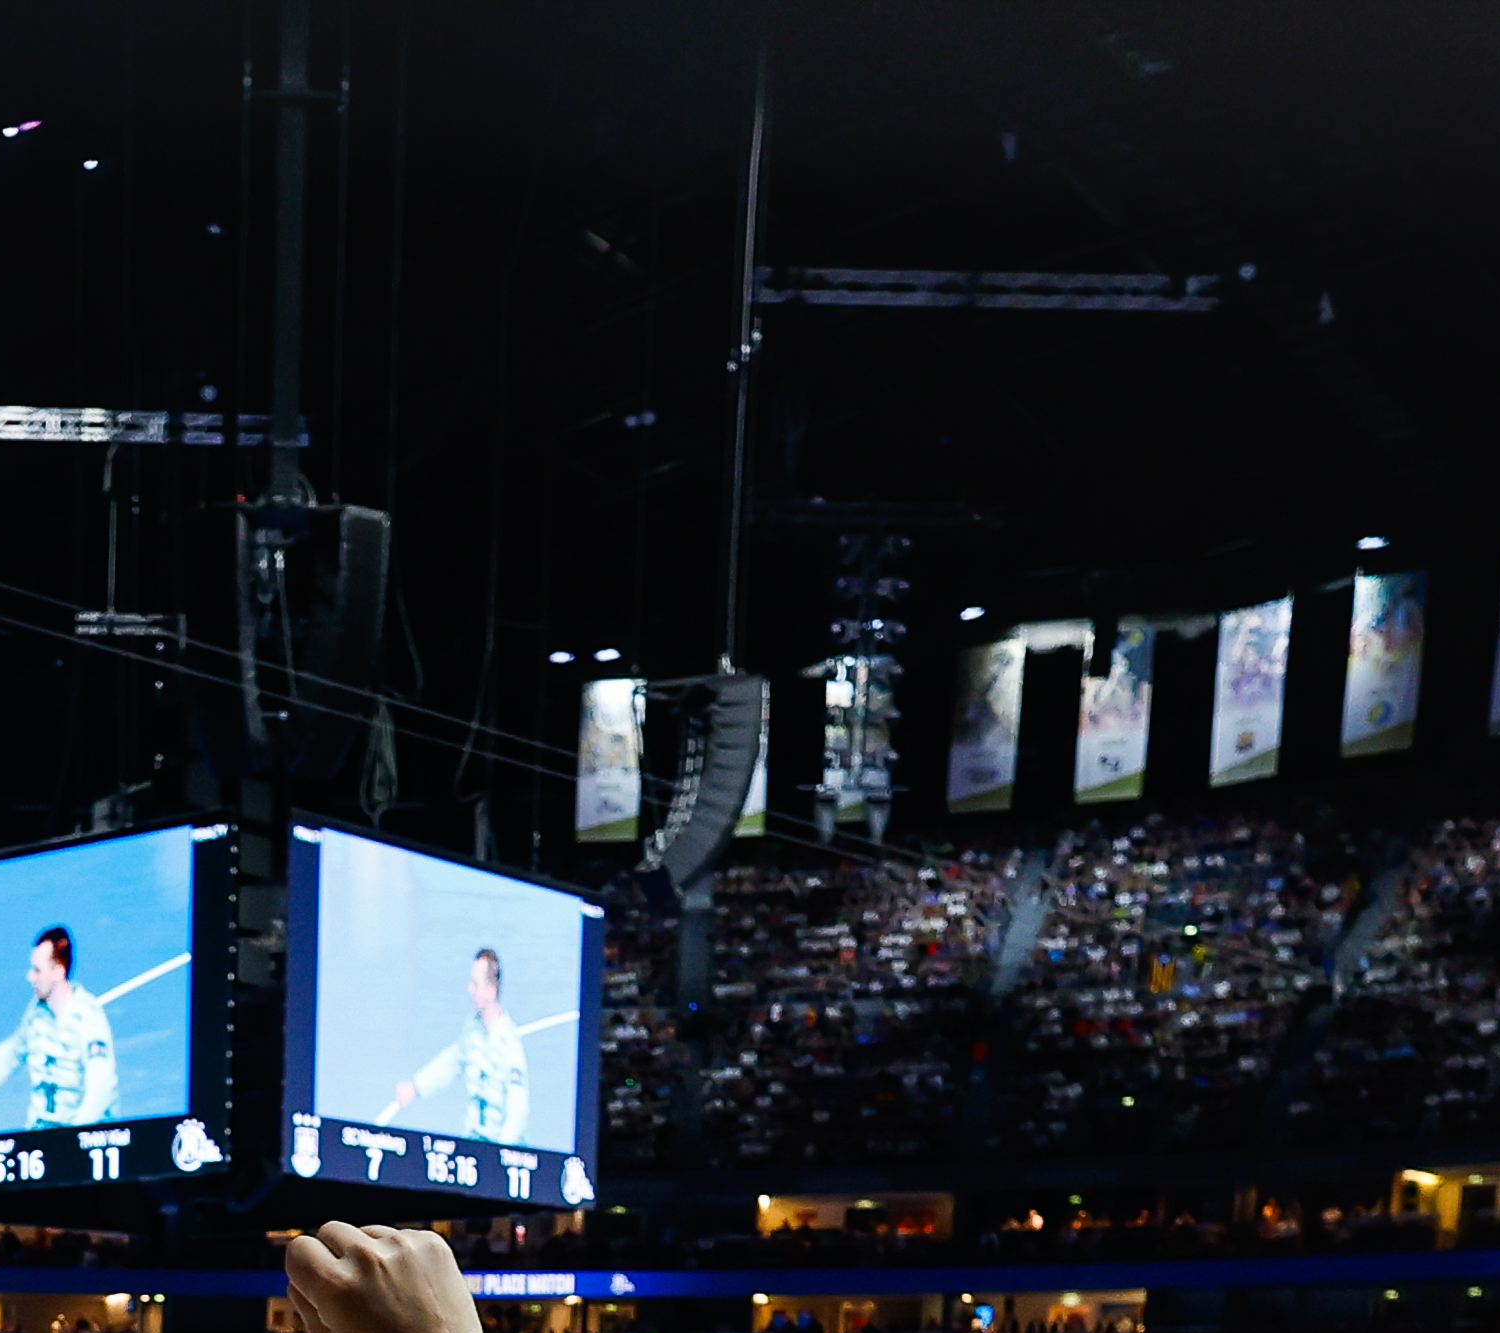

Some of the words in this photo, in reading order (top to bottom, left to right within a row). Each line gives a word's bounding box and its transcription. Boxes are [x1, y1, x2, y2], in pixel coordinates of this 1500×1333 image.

[89, 1147, 120, 1181] 11
[365, 1148, 384, 1182] 7
[507, 1166, 531, 1200] 11
